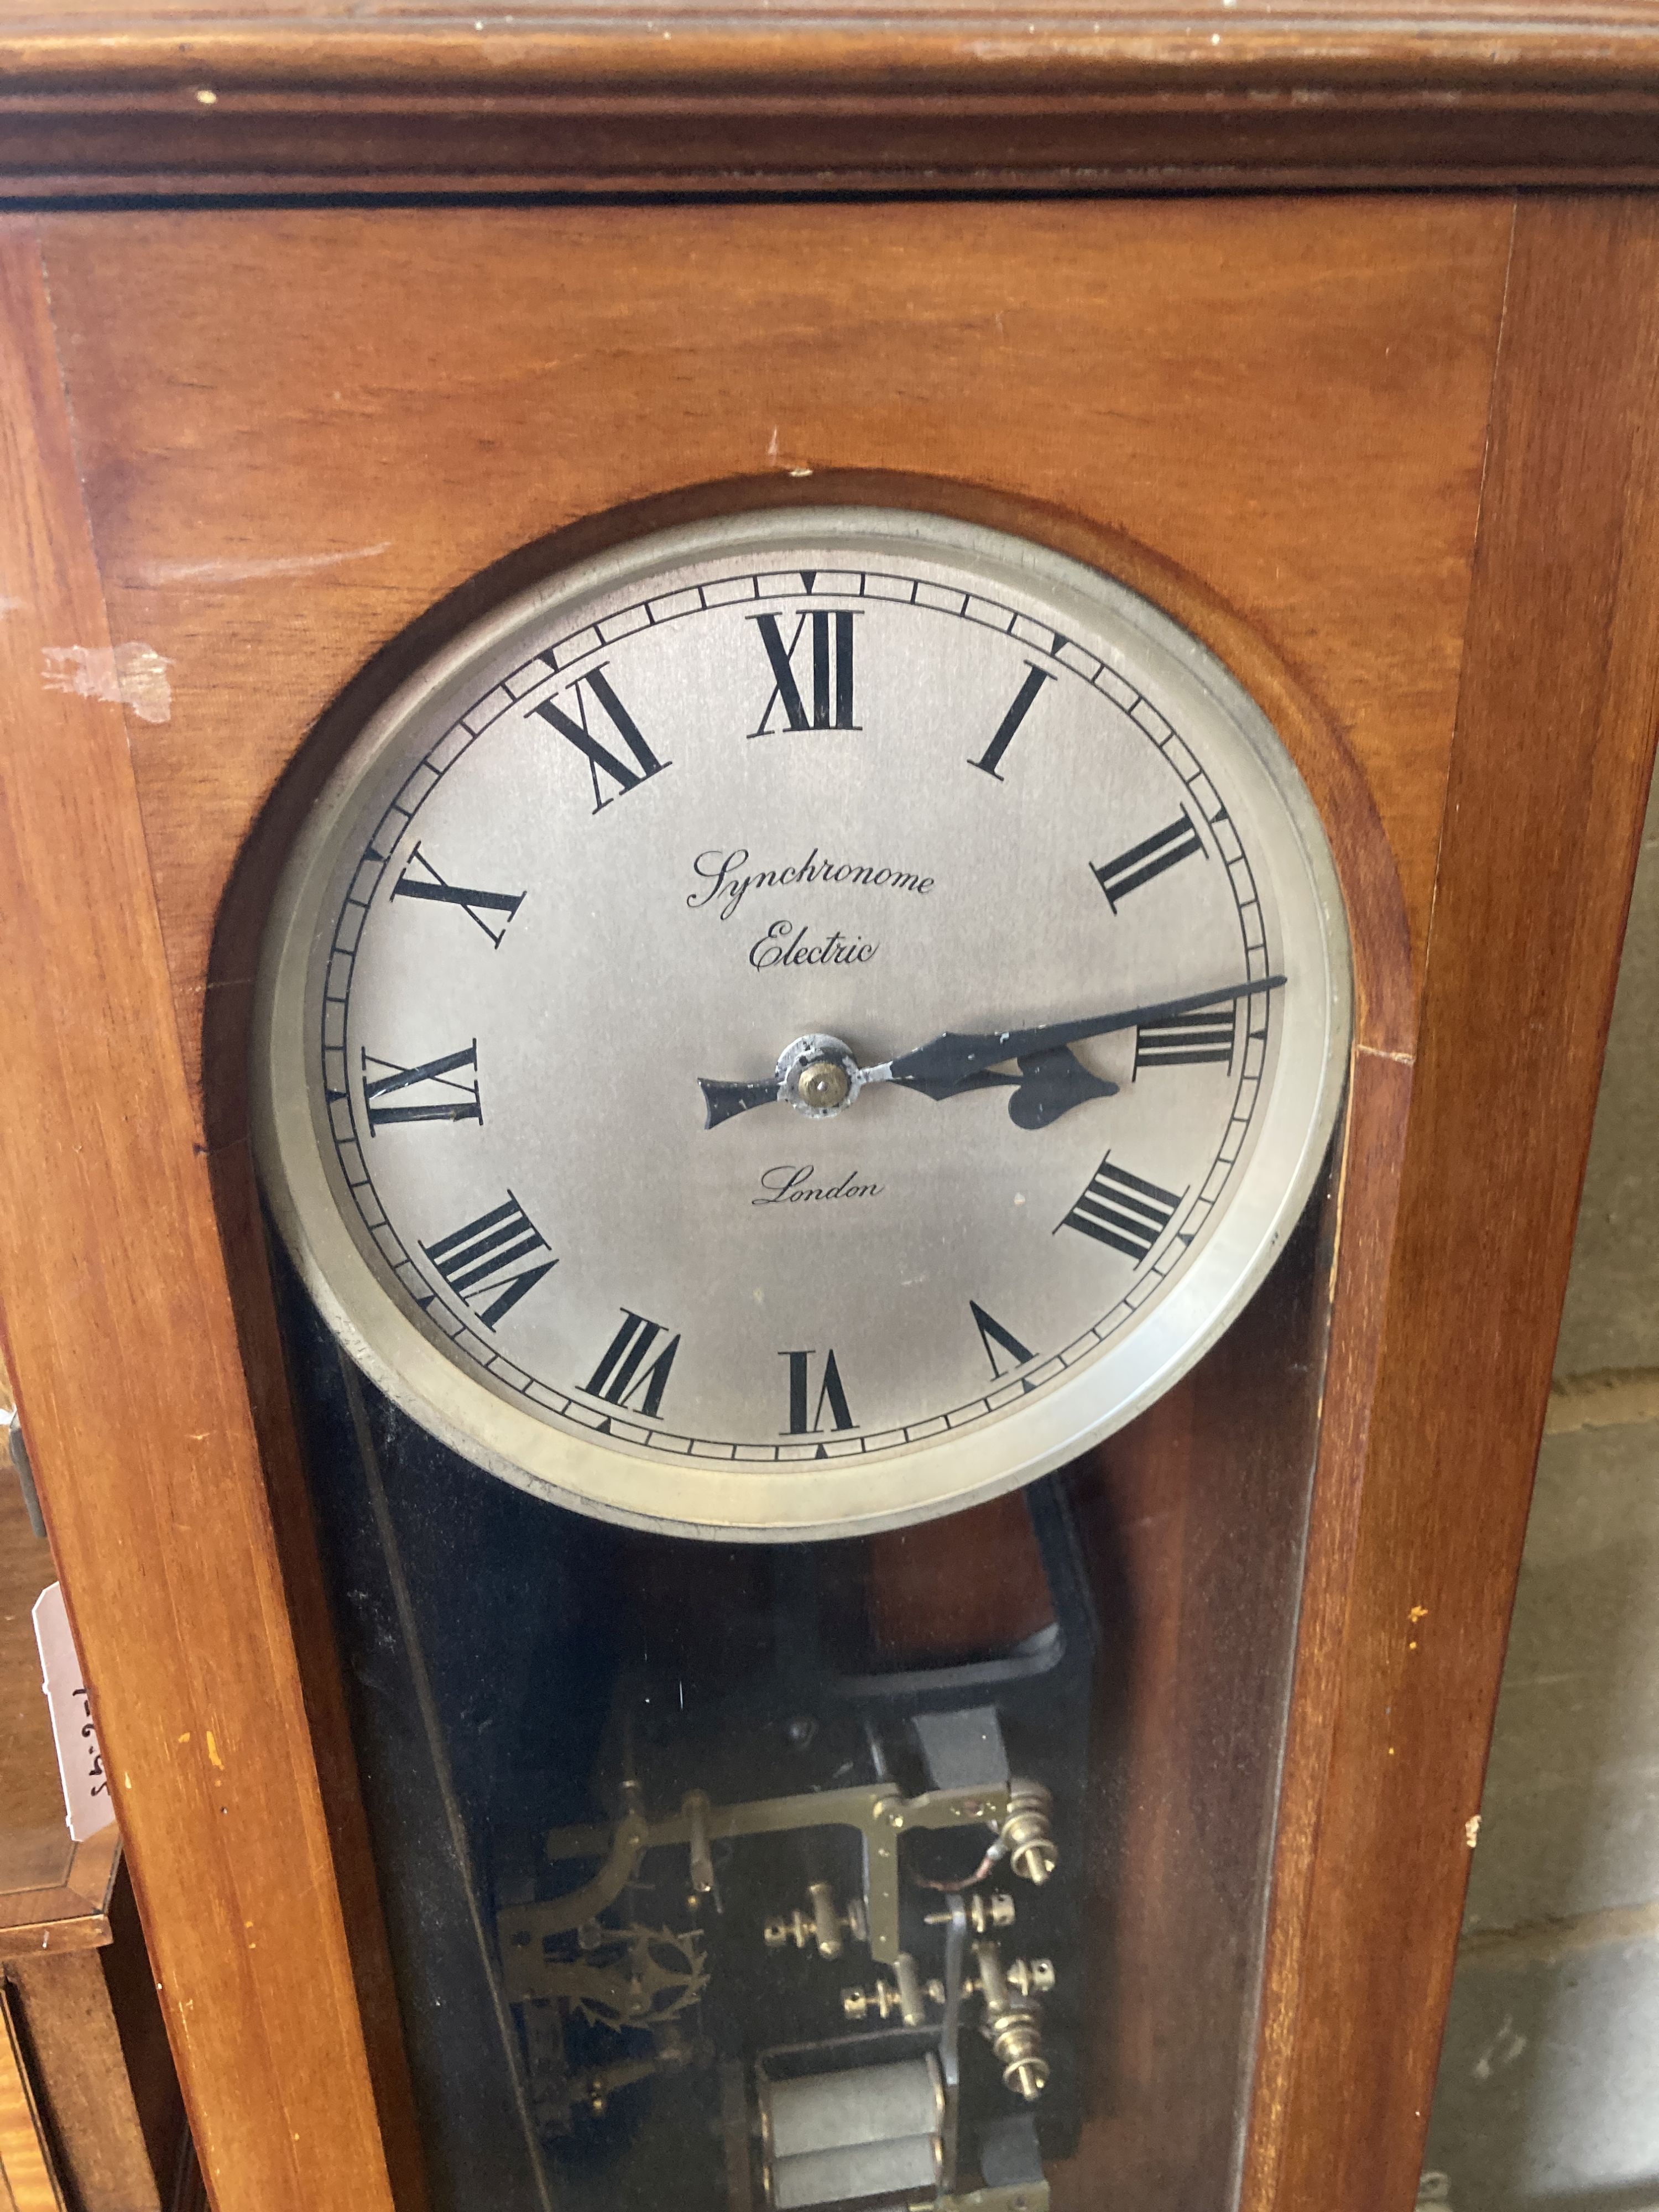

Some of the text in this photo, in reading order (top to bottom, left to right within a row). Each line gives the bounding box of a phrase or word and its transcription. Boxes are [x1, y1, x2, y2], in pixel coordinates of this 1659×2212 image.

[745, 609, 865, 739] XII
[967, 659, 1058, 782] I
[524, 660, 673, 815] XI
[389, 841, 527, 950] X
[687, 848, 935, 921] Synchronome
[1088, 802, 1209, 916] II
[749, 920, 880, 972] Electric
[361, 1037, 484, 1138] IX
[1132, 996, 1238, 1082] III
[752, 1165, 884, 1205] London
[1052, 1149, 1191, 1271] IIII
[418, 1189, 560, 1332] VIII
[575, 1307, 682, 1420] VII
[778, 1349, 860, 1435] VI
[969, 1300, 1040, 1382] V
